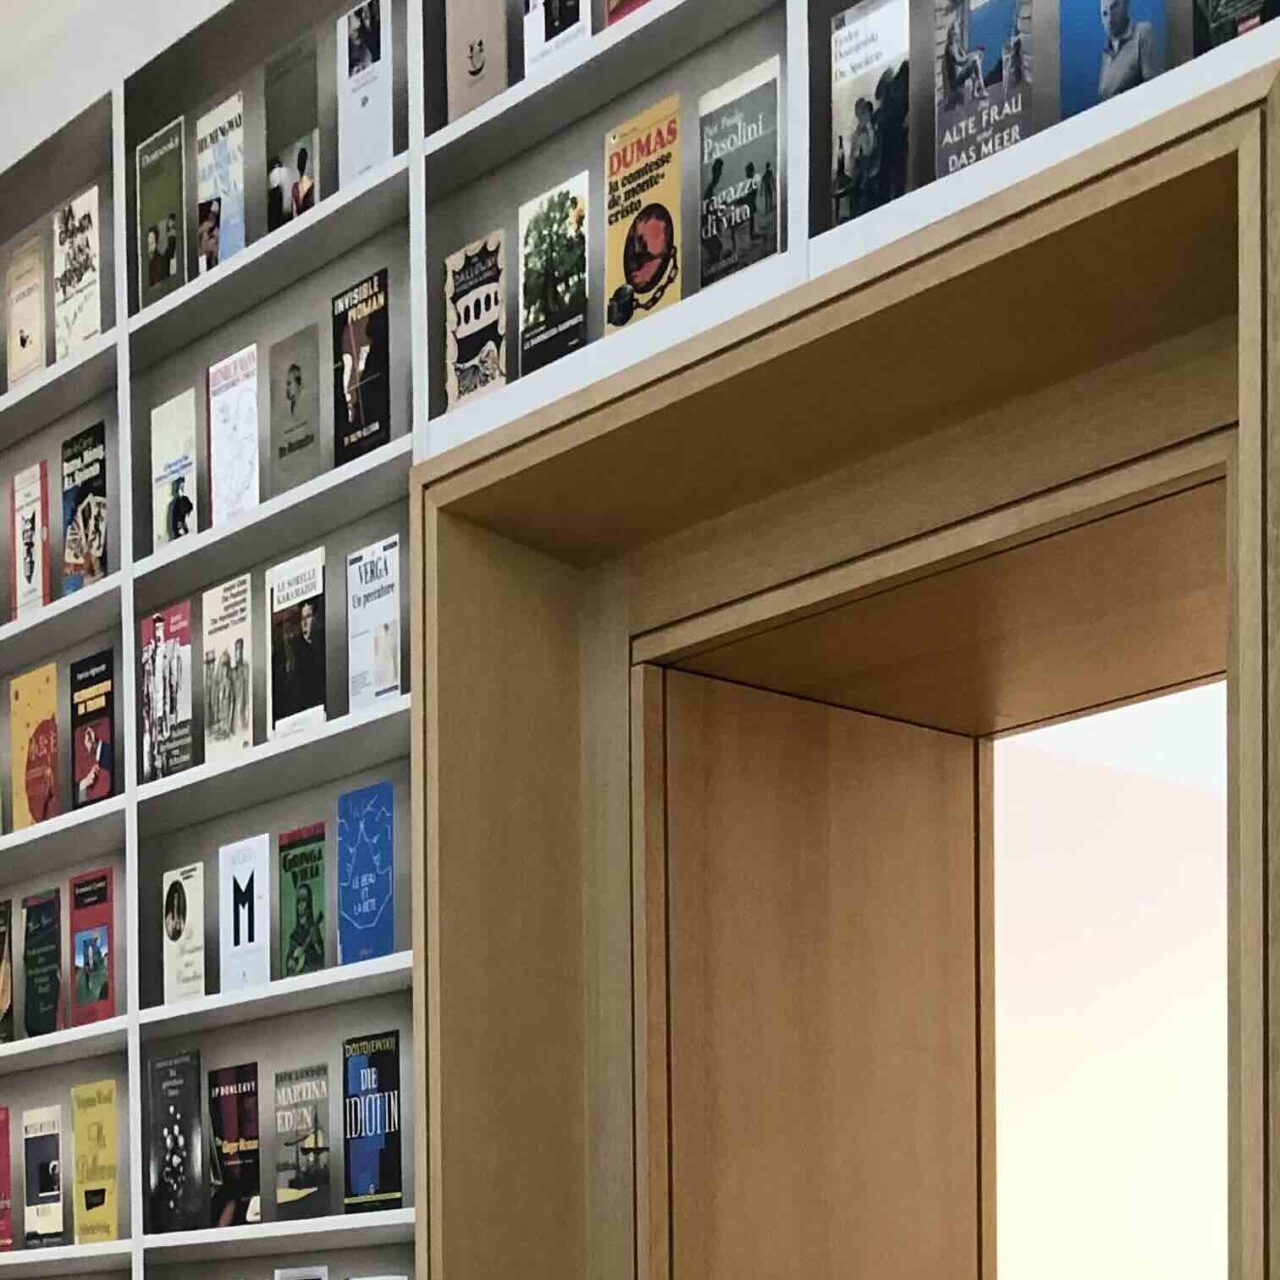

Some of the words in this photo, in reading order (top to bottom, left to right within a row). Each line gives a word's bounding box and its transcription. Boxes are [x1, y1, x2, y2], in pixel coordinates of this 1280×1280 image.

[703, 114, 763, 164] Pasolini
[942, 119, 977, 146] ALTE
[980, 94, 1022, 127] FRAU
[609, 118, 678, 177] DUMAS
[948, 146, 976, 173] DAS
[980, 125, 1021, 157] MEER
[608, 199, 642, 226] cristo
[702, 213, 717, 239] di
[334, 275, 379, 316] INVISIBLE
[358, 555, 389, 585] VERGA
[360, 1067, 377, 1090] DIE
[345, 1090, 400, 1139] IDIOTIN
